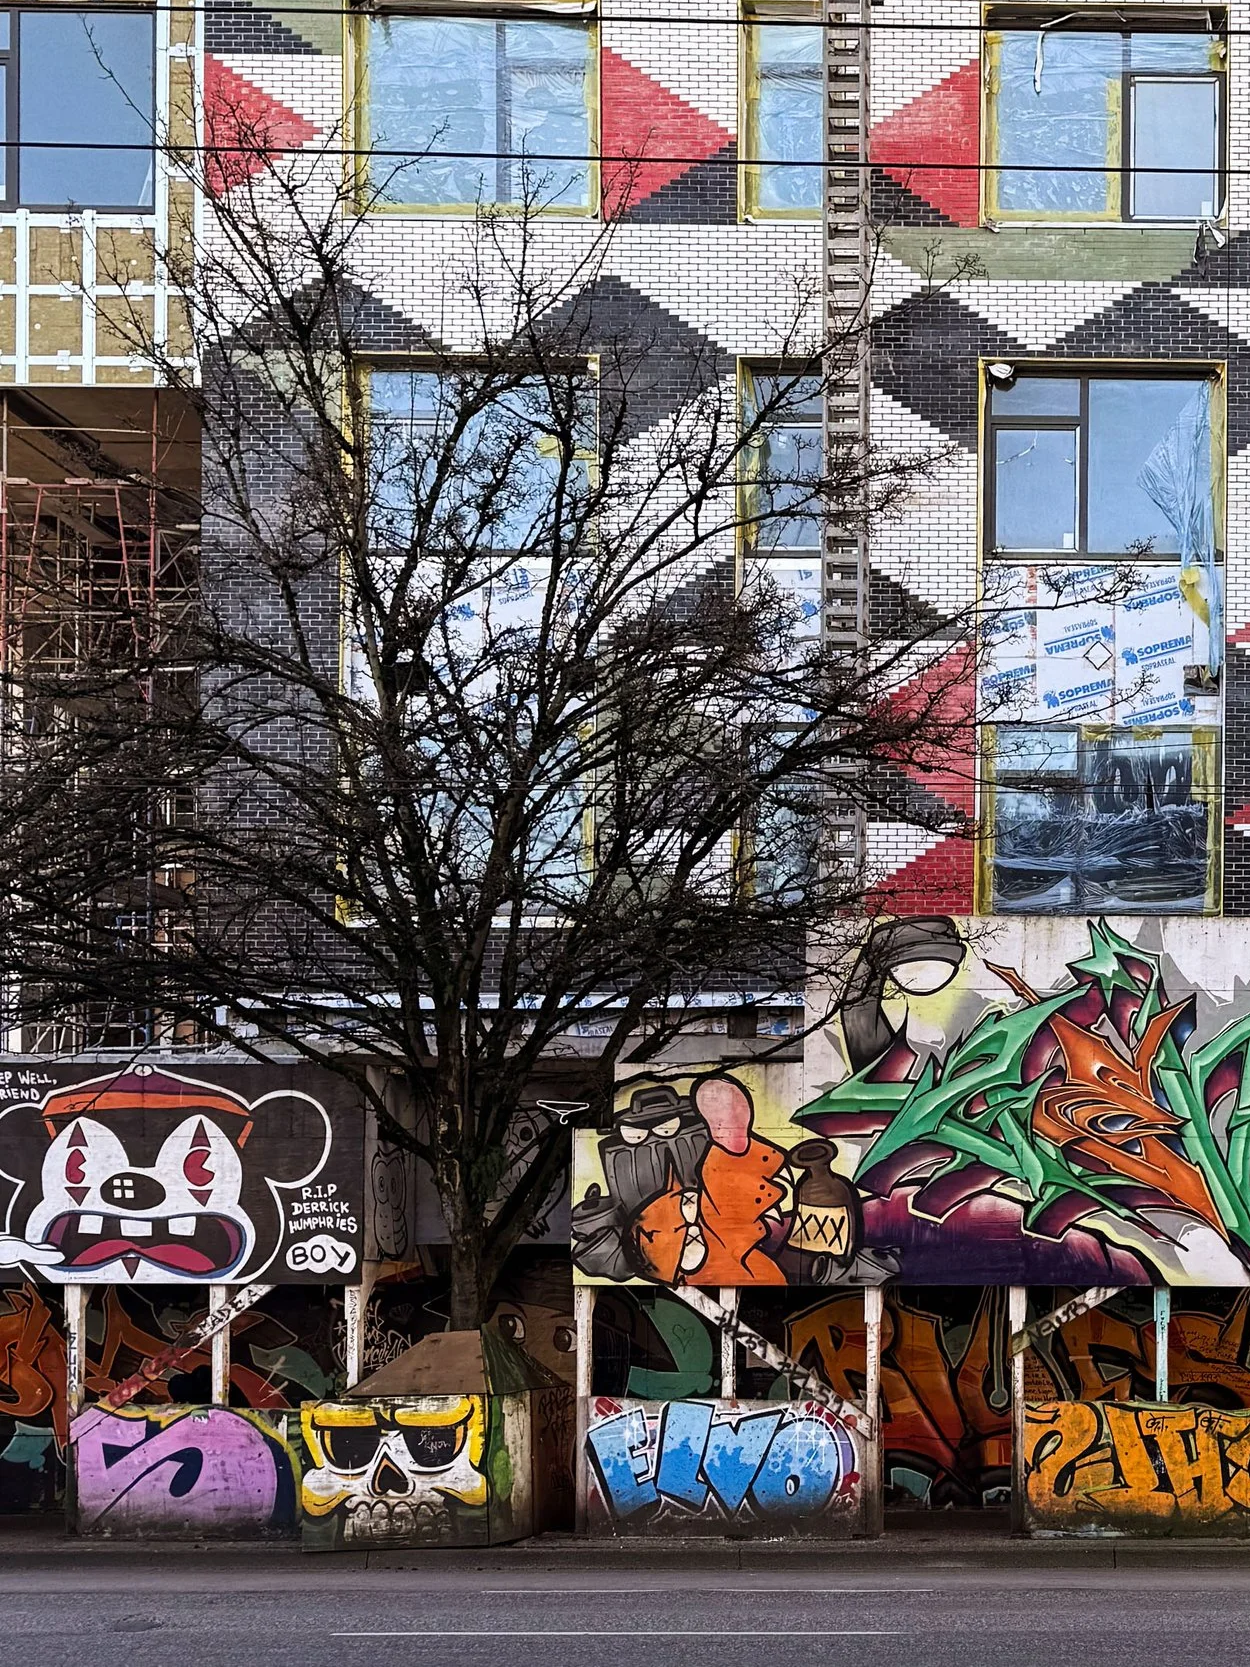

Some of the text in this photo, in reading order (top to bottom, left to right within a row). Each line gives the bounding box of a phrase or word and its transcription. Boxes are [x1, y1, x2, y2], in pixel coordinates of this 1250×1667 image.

[1064, 619, 1098, 633] SOPRASEAL
[1045, 634, 1101, 655] SOPREMA
[1138, 635, 1191, 657] SOPREMA
[1142, 658, 1176, 671] SOPRASEAL
[18, 1070, 57, 1085] WELL,
[302, 1184, 337, 1200] R.I.P
[291, 1198, 349, 1215] DERRICK
[289, 1213, 357, 1234] HUMPHRIES
[795, 1213, 845, 1250] XXX
[292, 1245, 350, 1267] BOY
